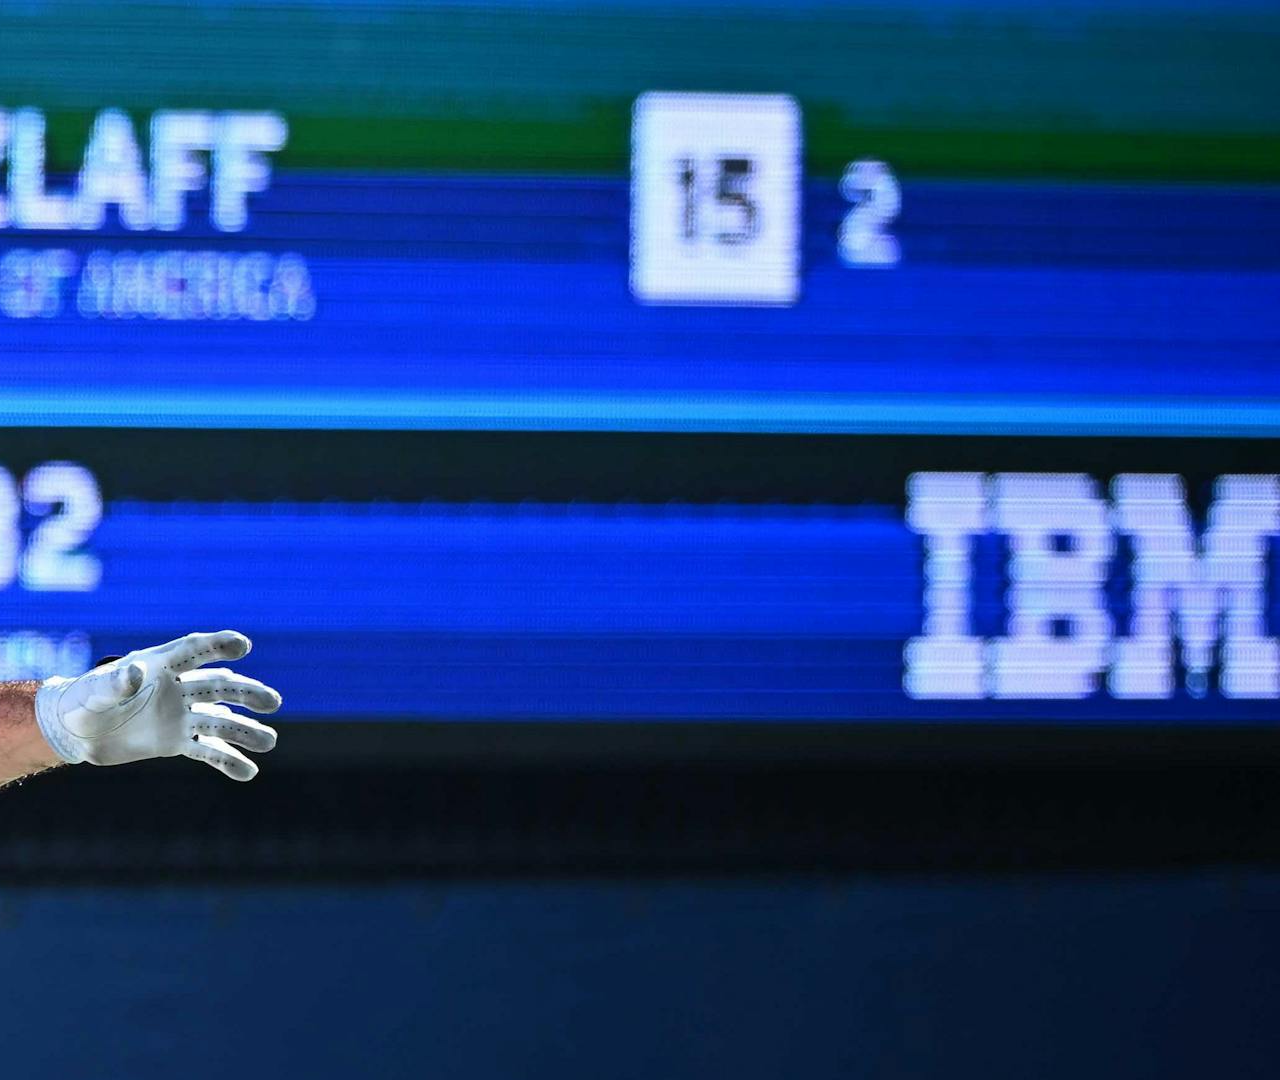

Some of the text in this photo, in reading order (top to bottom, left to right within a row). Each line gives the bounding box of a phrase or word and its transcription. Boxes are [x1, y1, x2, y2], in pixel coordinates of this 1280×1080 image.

[672, 156, 761, 248] 15
[838, 158, 903, 268] 2
[902, 470, 1280, 700] IBM
